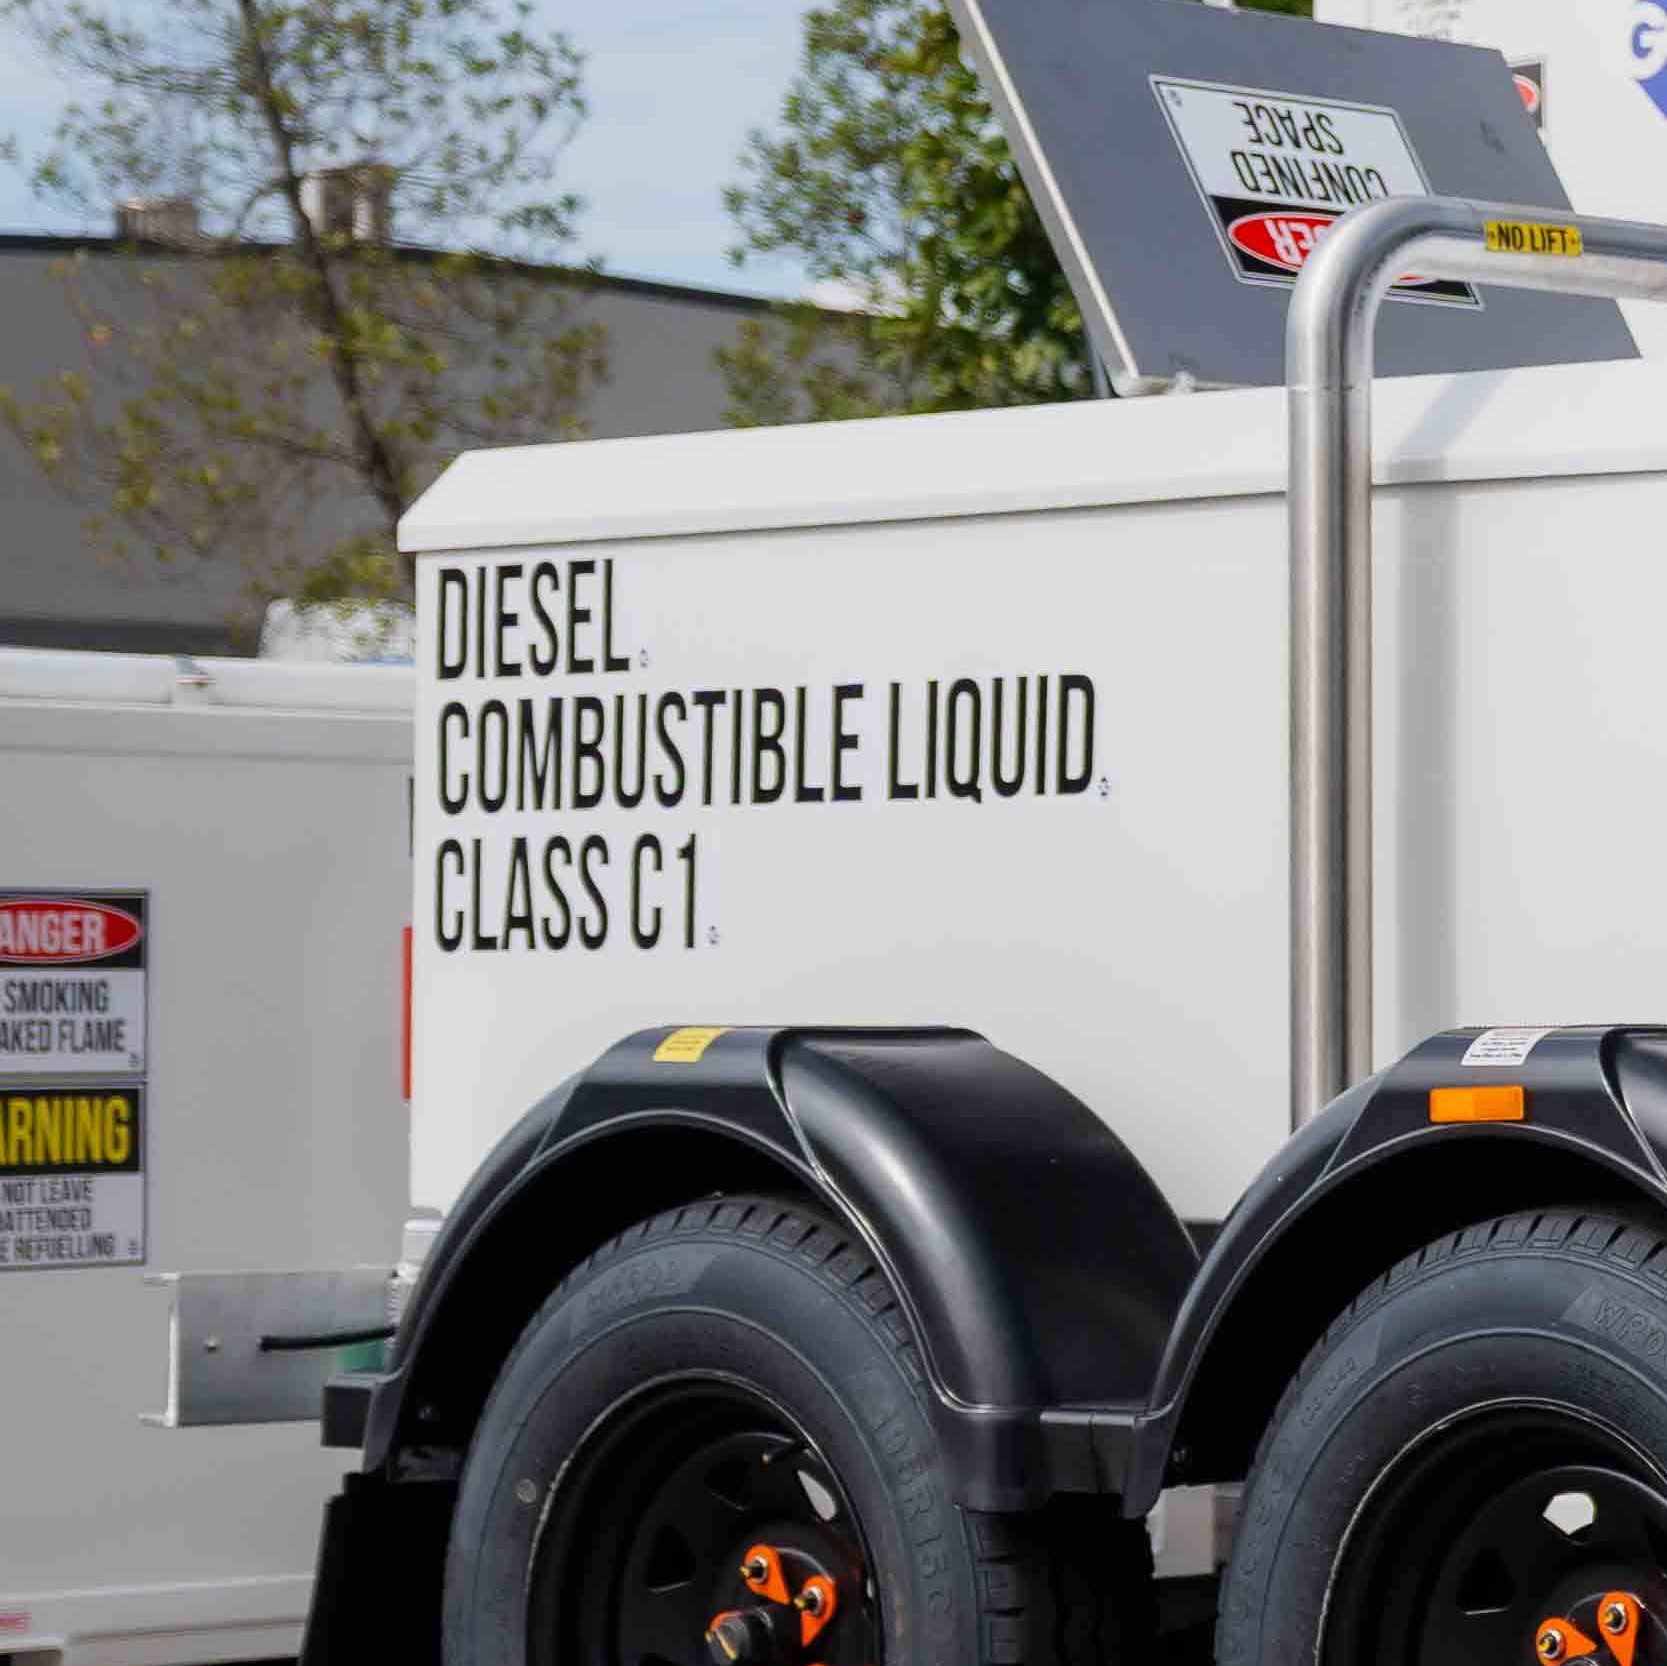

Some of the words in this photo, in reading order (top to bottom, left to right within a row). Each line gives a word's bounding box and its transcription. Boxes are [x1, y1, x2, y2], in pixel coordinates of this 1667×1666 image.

[1232, 99, 1344, 155] SPACE
[1230, 150, 1390, 205] CONFINED
[1497, 223, 1524, 250] NO
[1528, 226, 1569, 254] LIFT
[436, 558, 630, 680] DIESEL
[436, 683, 865, 815] COMBUSTIBLE
[888, 674, 1096, 804] LIQUID
[435, 834, 611, 952] CLASS
[630, 832, 698, 951] C1
[0, 909, 107, 955] ANGER
[4, 980, 109, 1014] SMOKING
[0, 1020, 52, 1053] AKED
[58, 1018, 125, 1052] FLAME
[0, 1096, 129, 1165] RNING
[2, 1181, 35, 1204] NOT
[40, 1179, 94, 1203] LEAVE
[0, 1208, 91, 1232] ATTENDED
